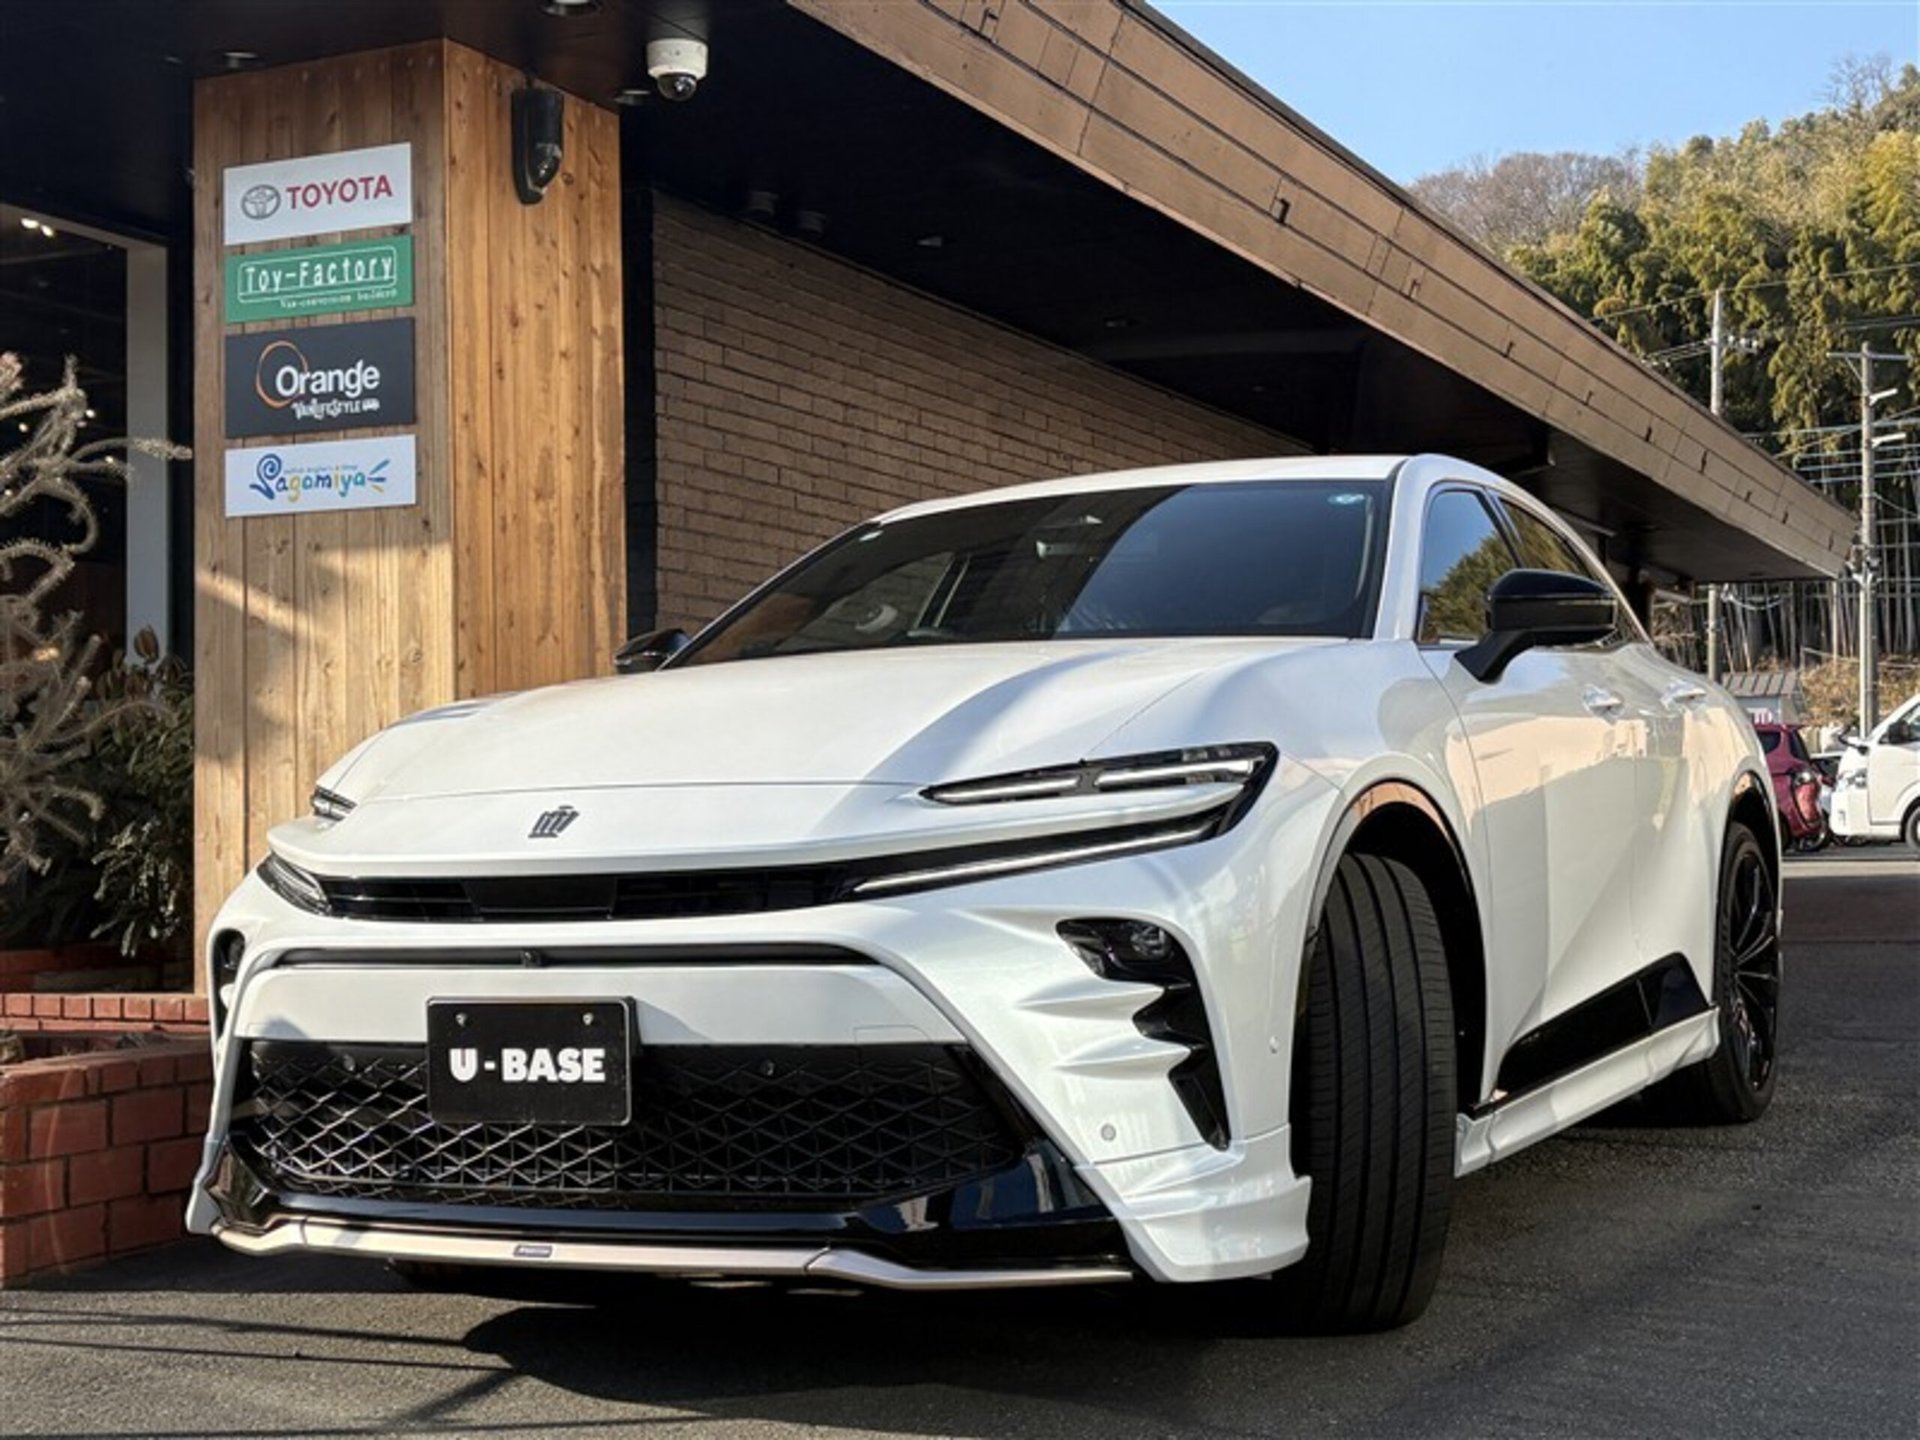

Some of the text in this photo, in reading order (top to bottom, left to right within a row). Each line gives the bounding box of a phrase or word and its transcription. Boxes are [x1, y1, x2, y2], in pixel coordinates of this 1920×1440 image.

[286, 174, 393, 210] TOYOTA
[245, 256, 393, 293] Toy-Factory
[275, 359, 381, 398] Orange
[449, 1047, 606, 1083] U-BASE
